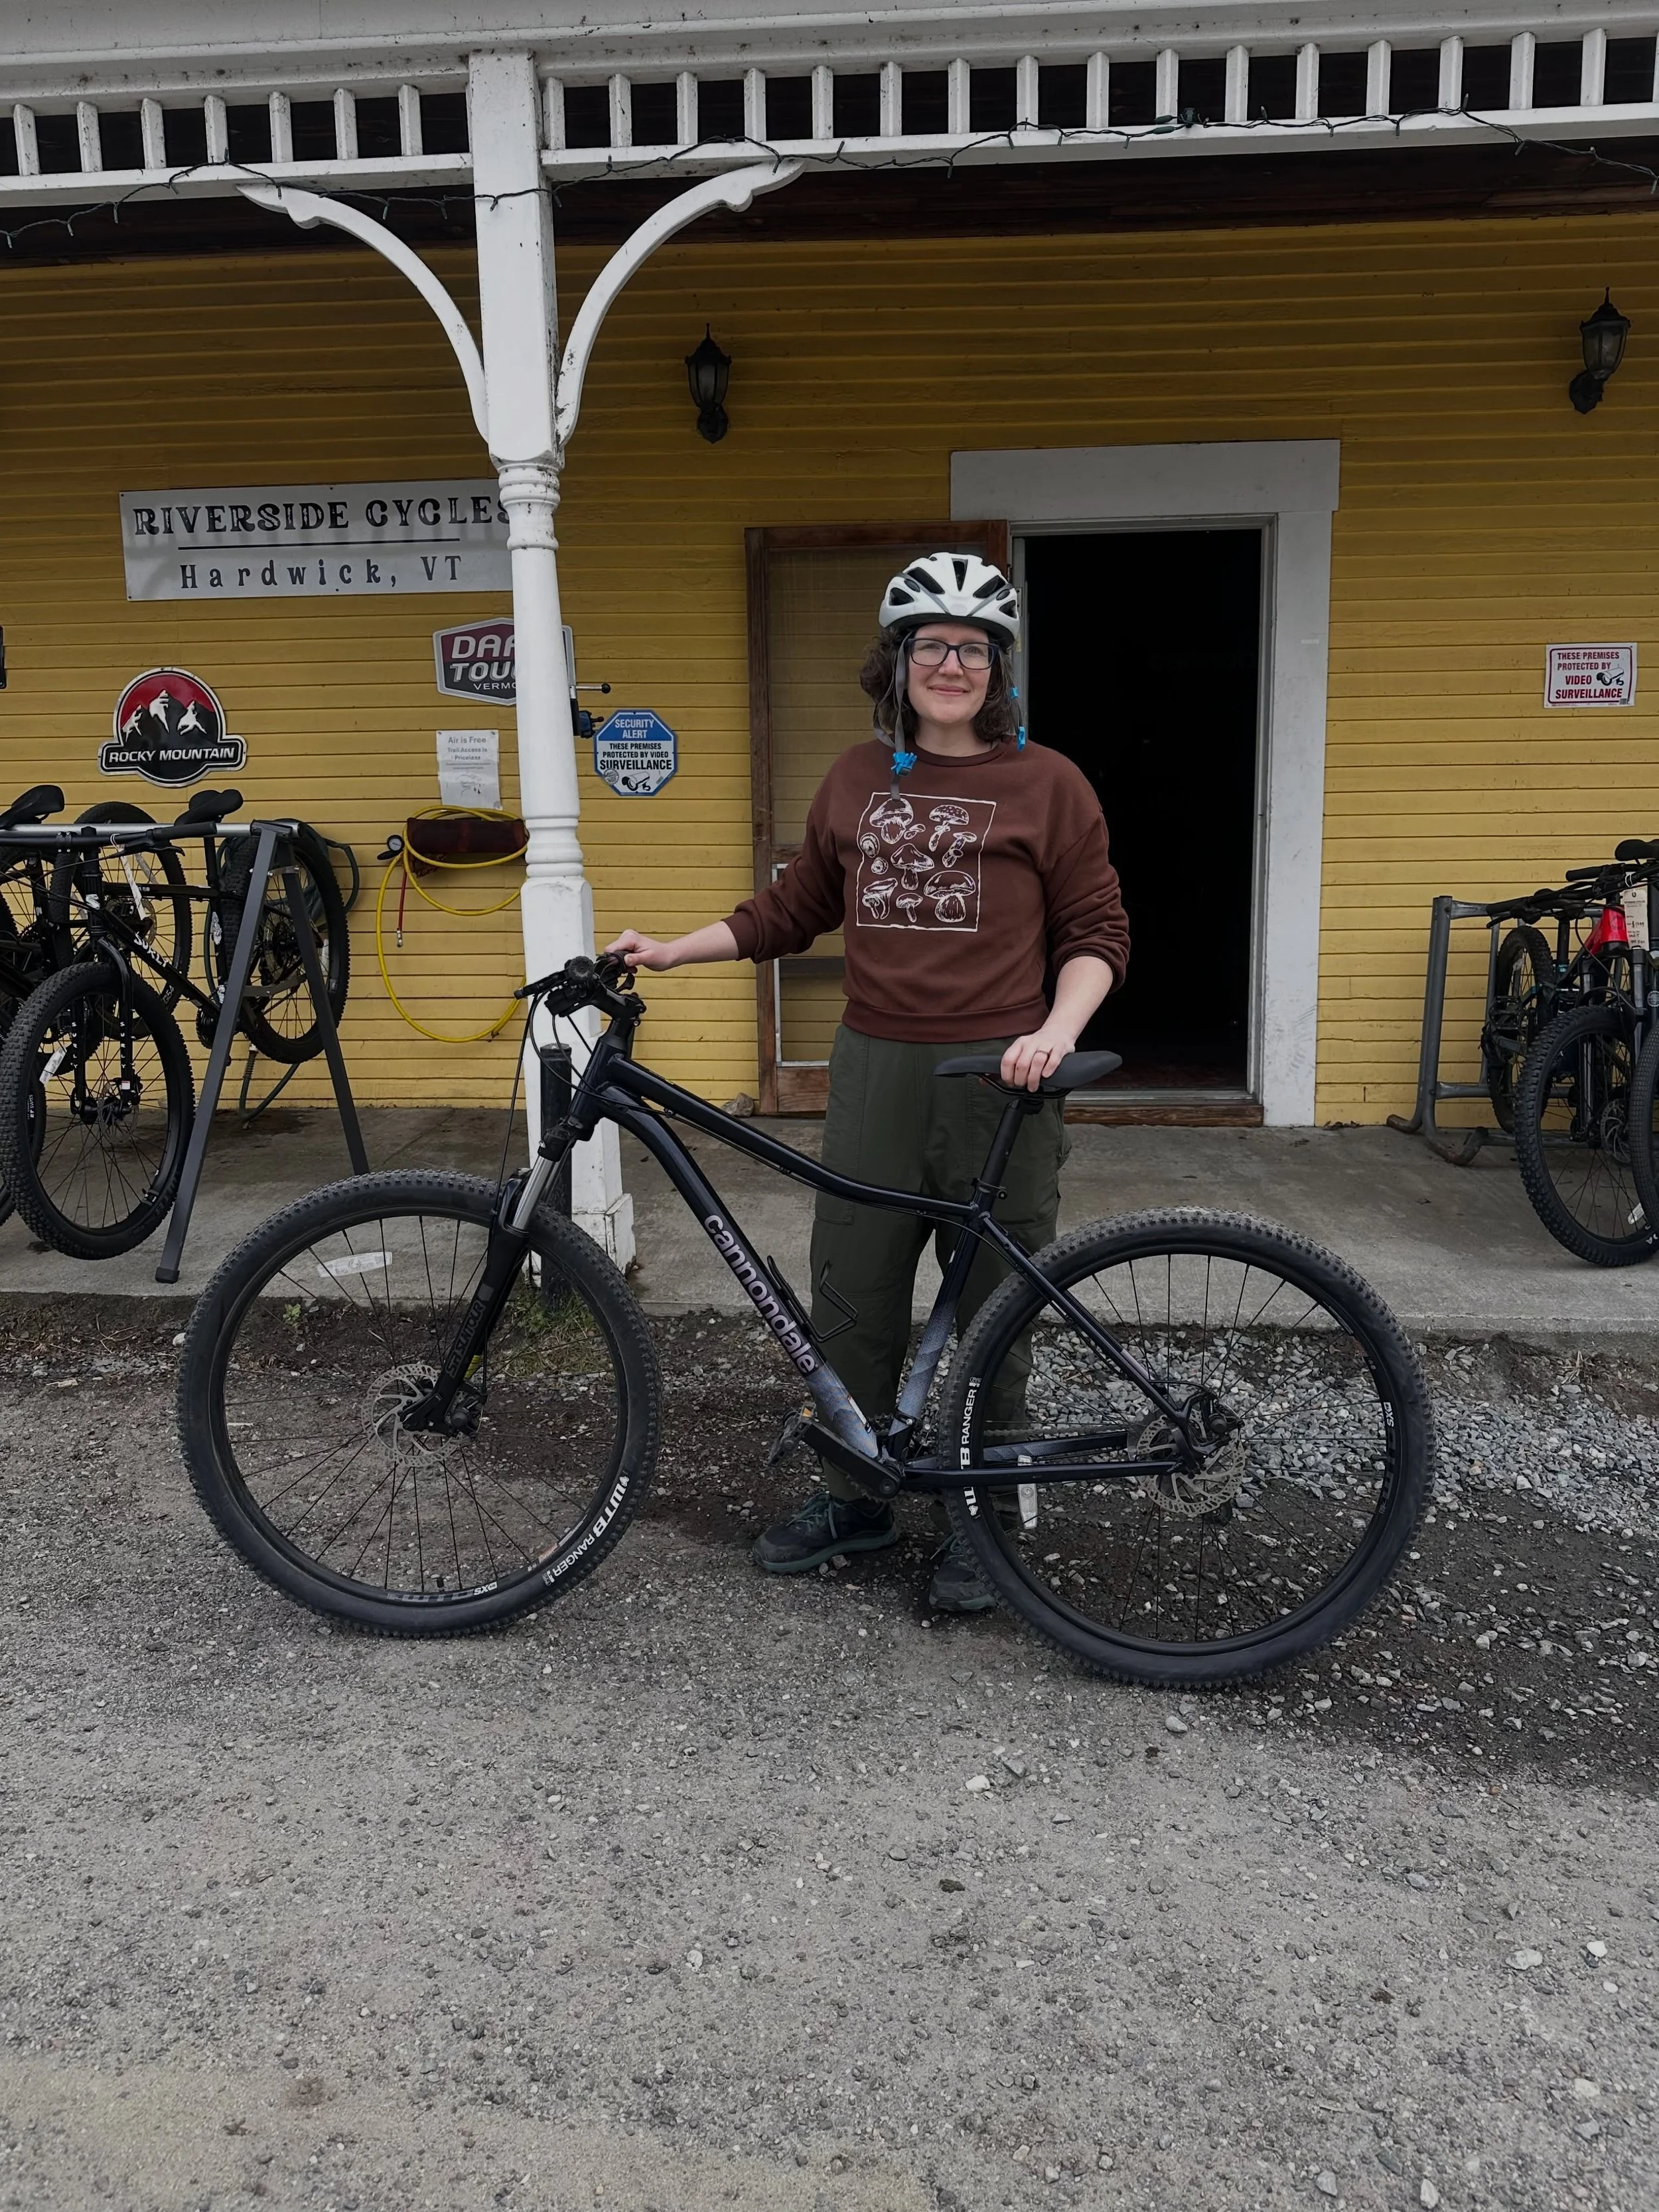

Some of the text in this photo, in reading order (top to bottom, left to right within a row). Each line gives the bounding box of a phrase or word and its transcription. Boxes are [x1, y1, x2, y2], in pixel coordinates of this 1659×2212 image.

[133, 502, 348, 535] RIVERSIDE
[180, 555, 461, 588] Hardwick, VT
[450, 662, 516, 682] TOU
[1565, 675, 1592, 685] VIDEO
[1555, 688, 1623, 699] SURVEILLANCE
[614, 719, 654, 728] SECURITY
[622, 729, 648, 739] ALERT
[109, 747, 235, 763] ROCKY MOUNTAIN
[600, 760, 672, 770] SURVEILLANCE
[133, 931, 169, 968] SURLY
[704, 1215, 816, 1373] cannondale
[962, 1388, 977, 1444] RANGER
[552, 1483, 627, 1577] WTB RANGER
